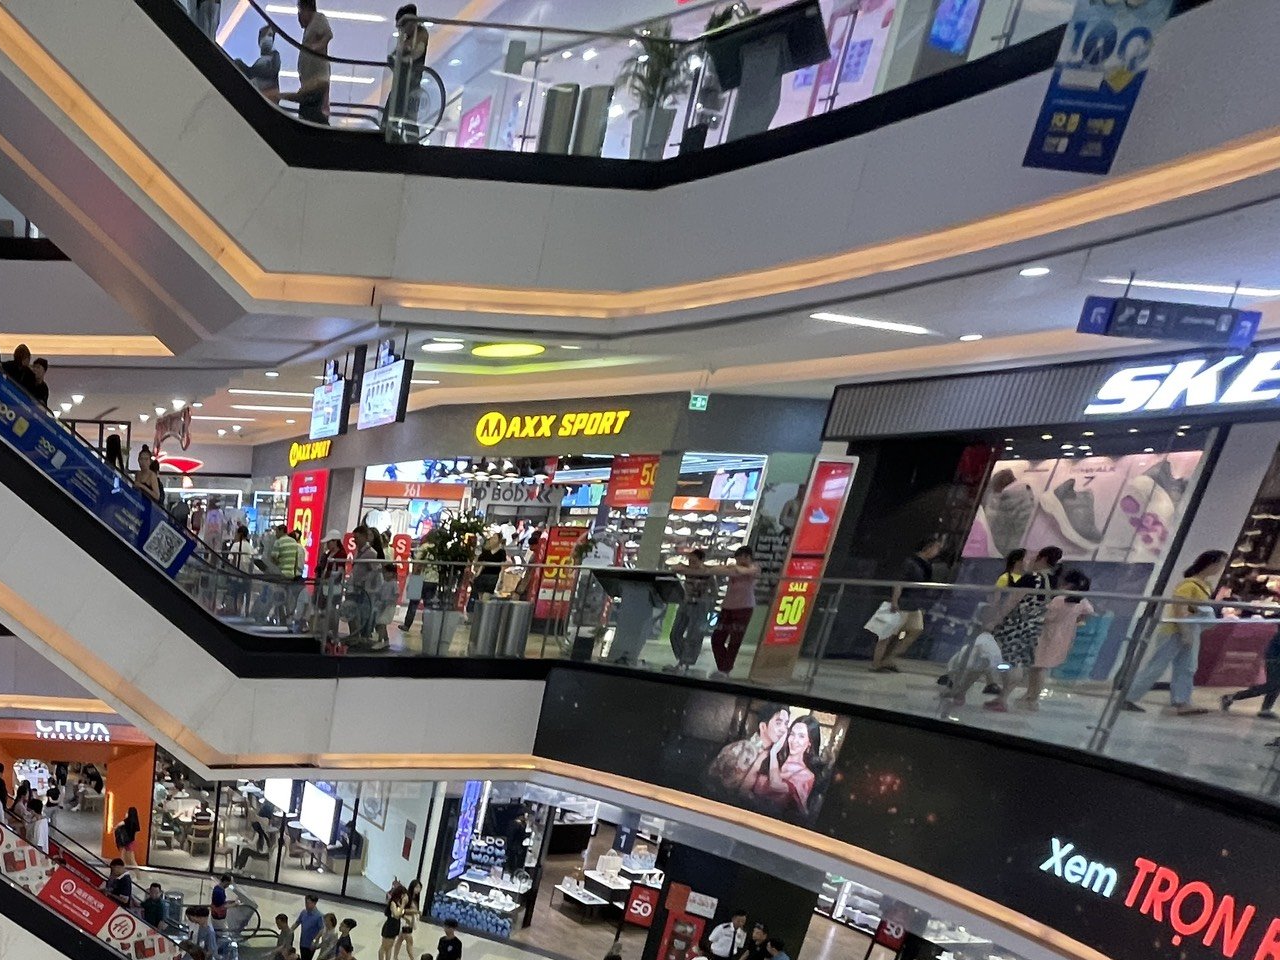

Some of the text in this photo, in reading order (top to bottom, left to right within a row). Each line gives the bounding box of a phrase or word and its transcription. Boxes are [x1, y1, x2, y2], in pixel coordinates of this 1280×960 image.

[1083, 350, 1280, 415] SKE
[558, 410, 631, 437] SPORT
[788, 581, 809, 593] SALE
[629, 899, 653, 918] 50
[1039, 837, 1118, 898] Xem
[1124, 857, 1257, 958] TRỌN
